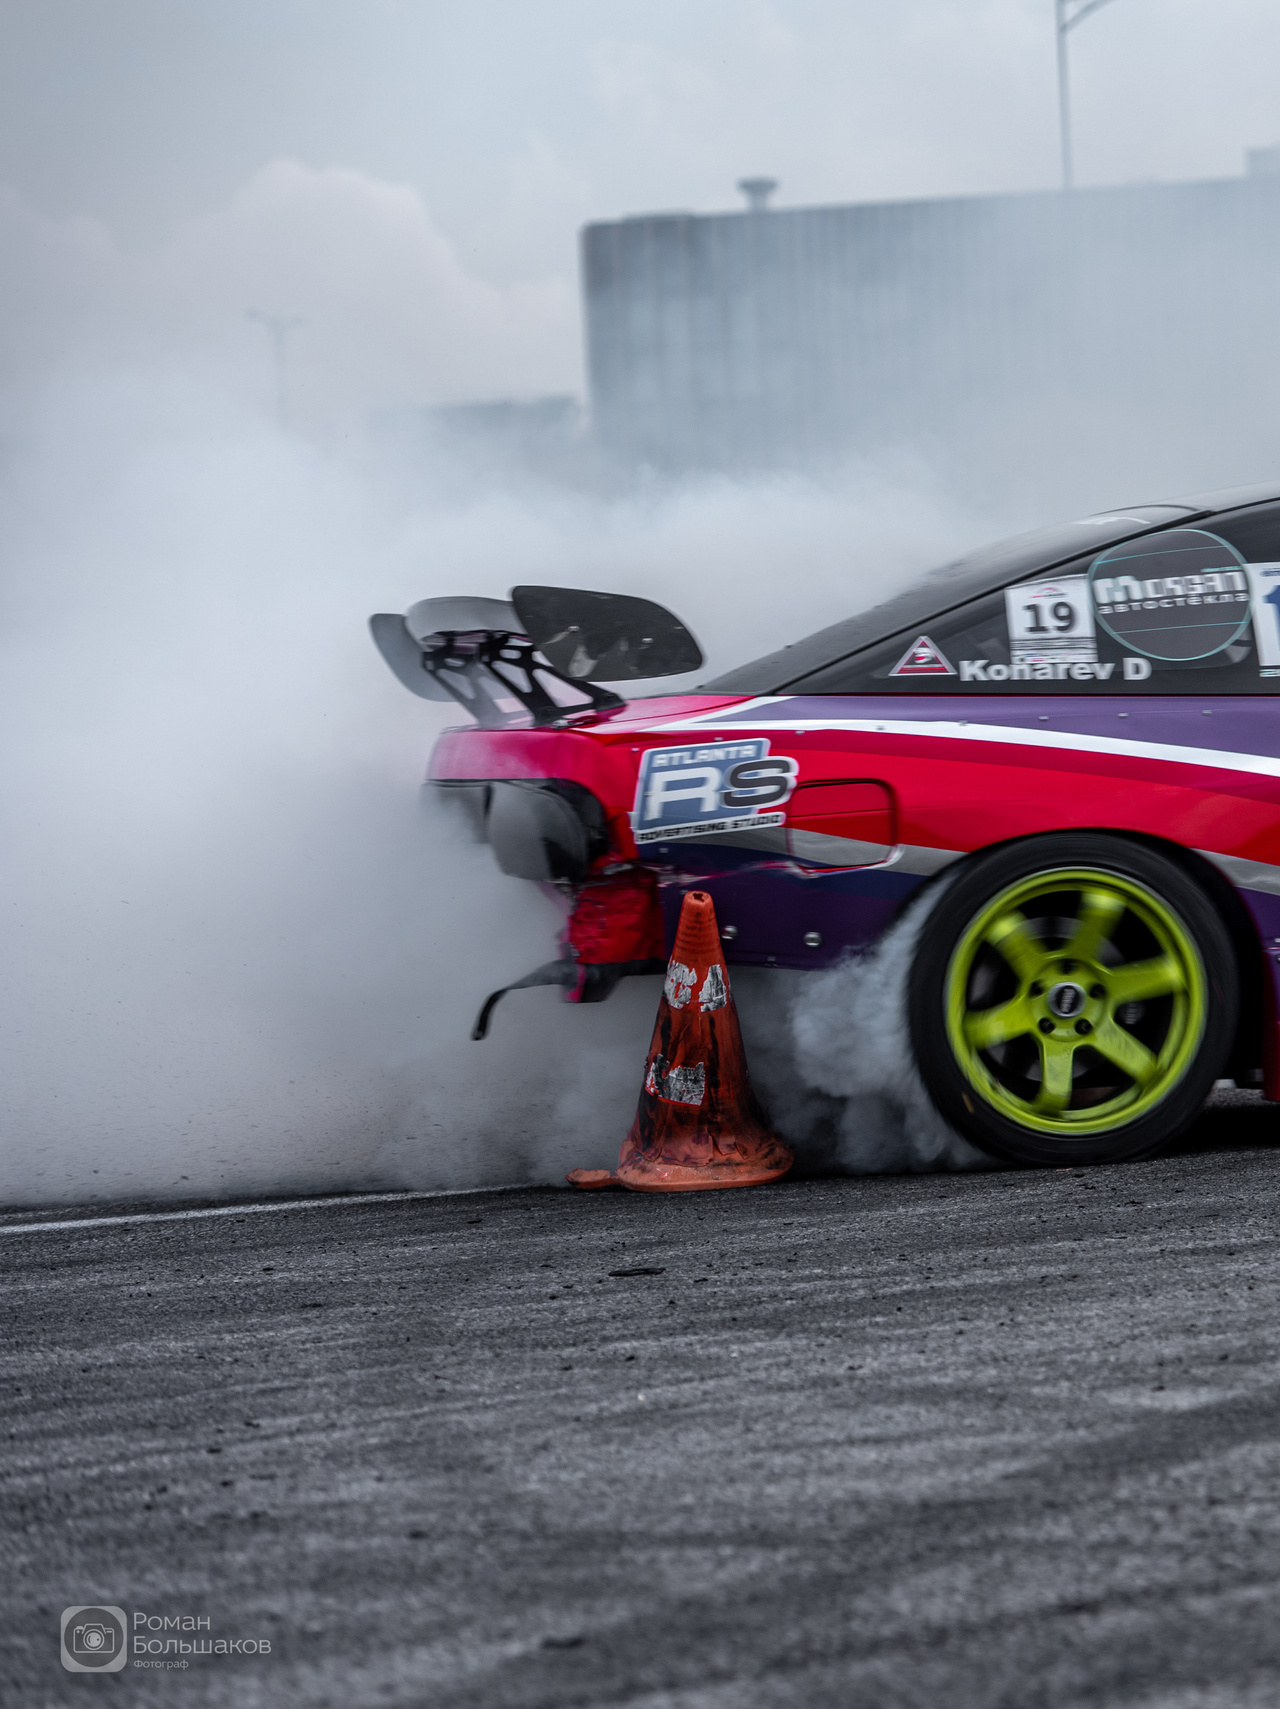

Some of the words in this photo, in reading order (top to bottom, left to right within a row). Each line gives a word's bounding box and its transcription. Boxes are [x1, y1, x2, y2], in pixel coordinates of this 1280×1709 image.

[1024, 601, 1078, 633] 19
[1098, 593, 1250, 615] автостёкла
[958, 659, 1115, 682] Konarev
[1122, 657, 1152, 681] D
[652, 744, 757, 768] ATLANTA
[643, 758, 791, 821] RS
[637, 820, 728, 843] ADVERTISING
[731, 812, 782, 830] STUDIO
